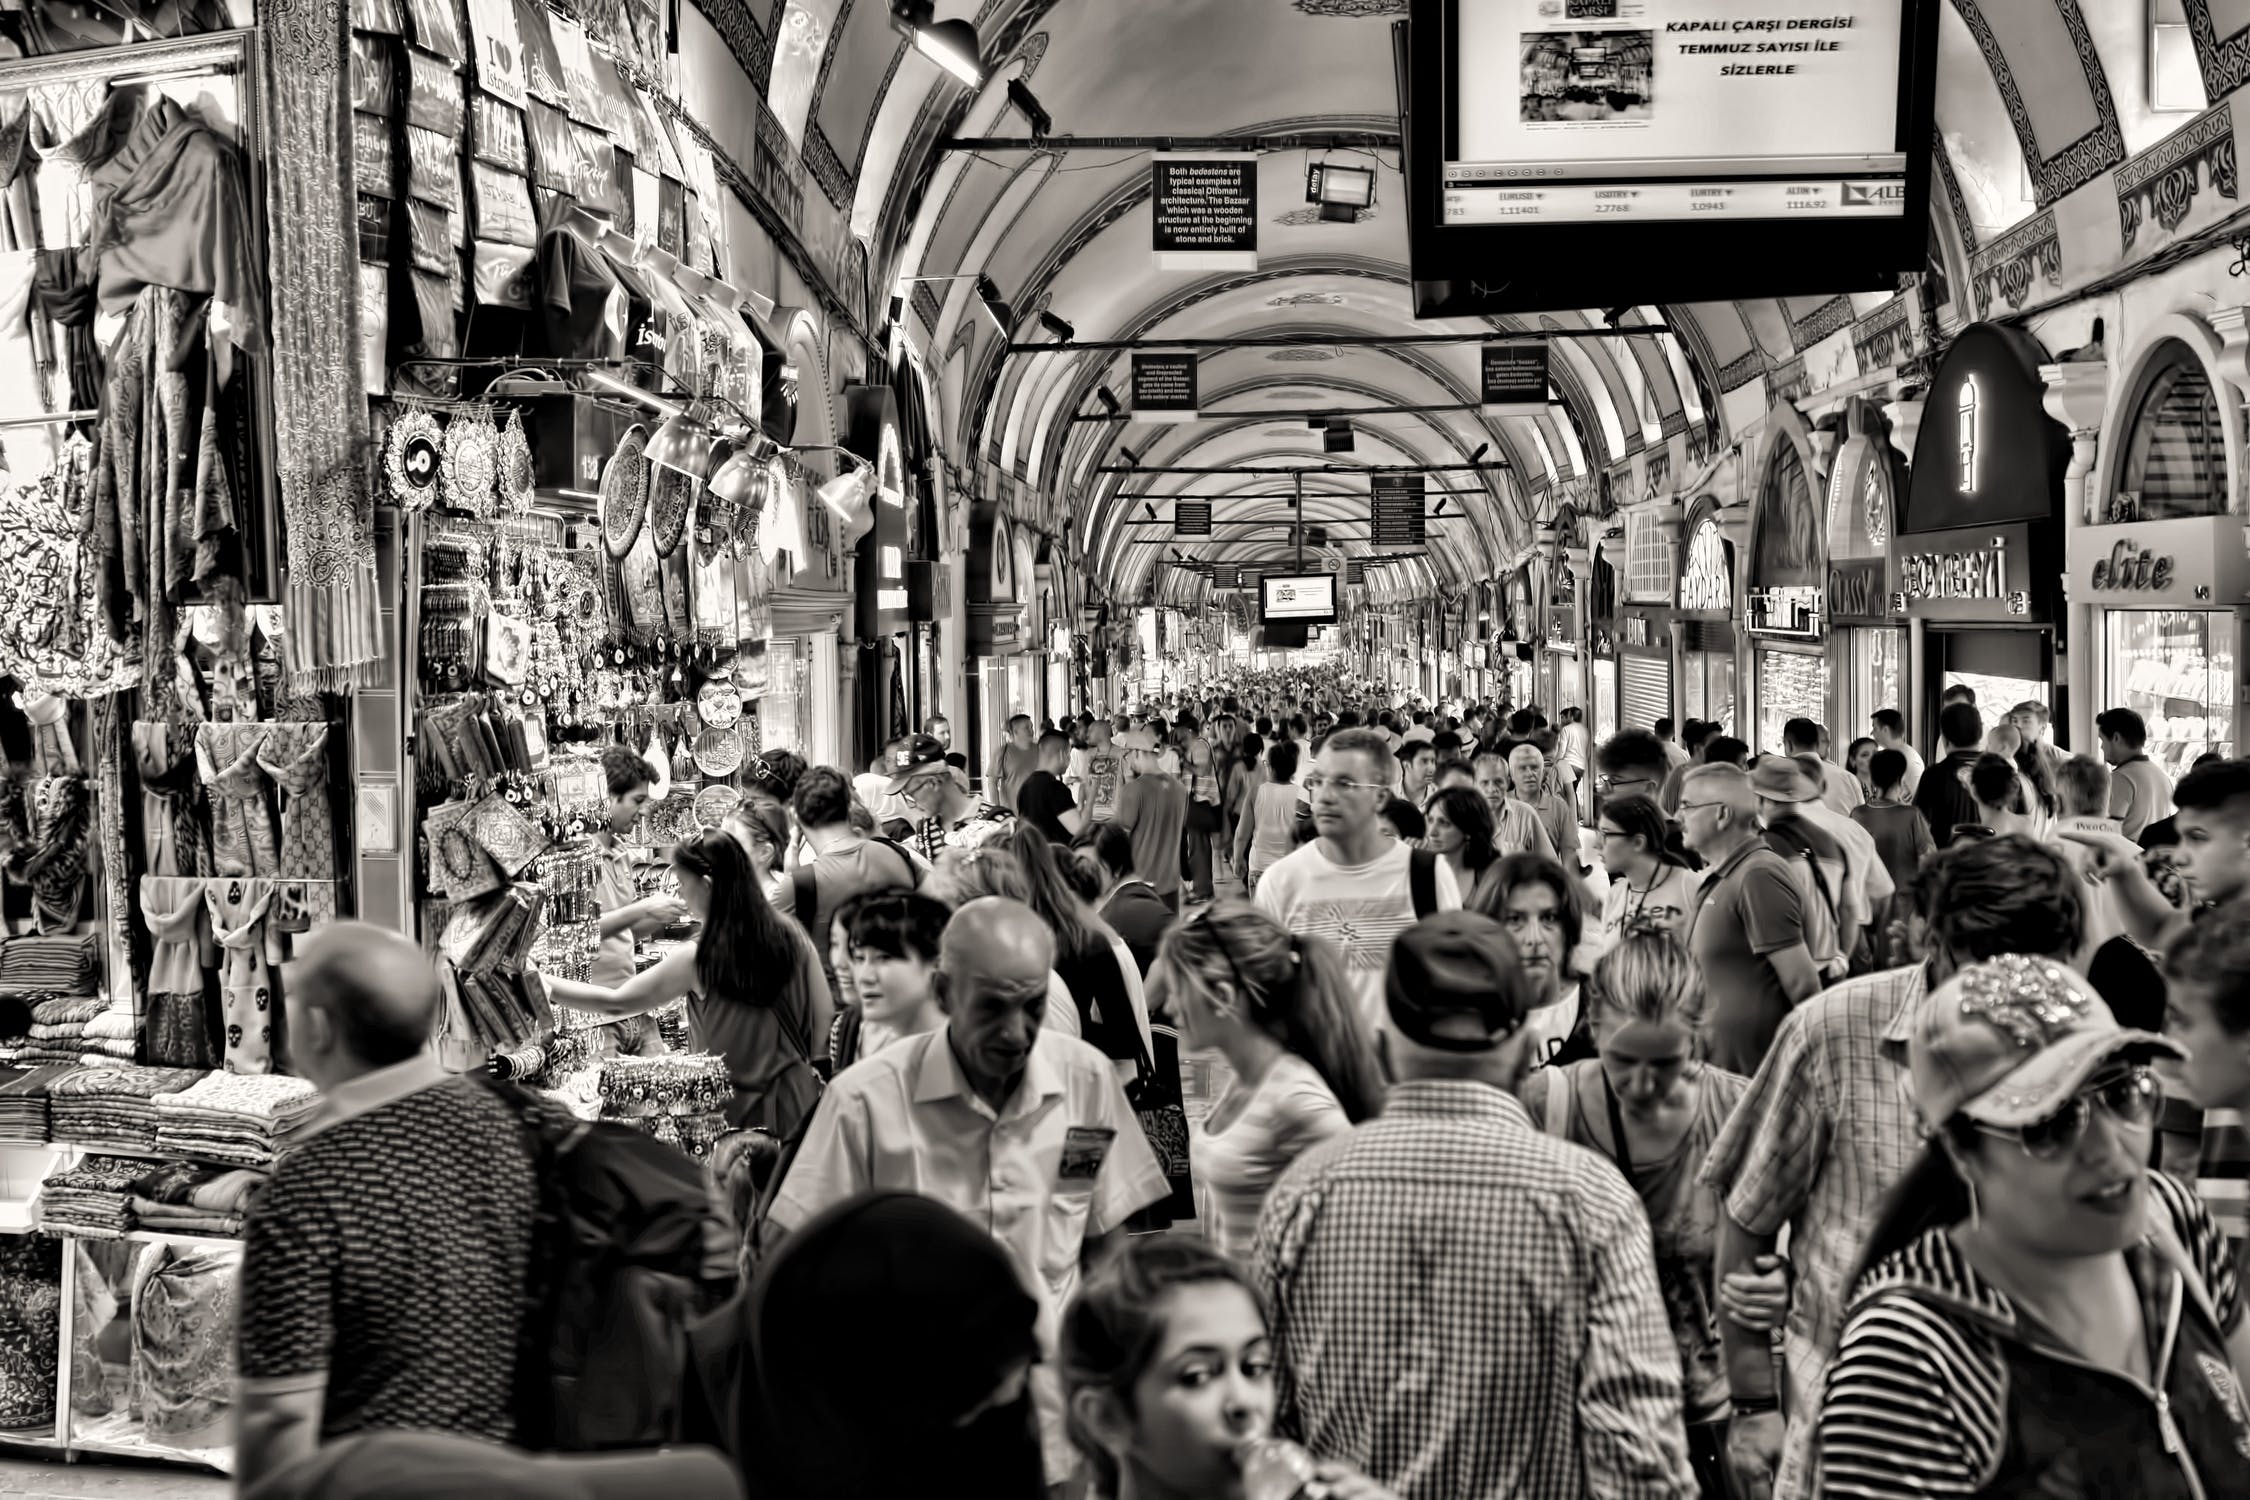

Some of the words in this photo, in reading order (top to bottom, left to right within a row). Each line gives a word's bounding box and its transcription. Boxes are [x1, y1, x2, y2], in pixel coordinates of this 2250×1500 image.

[1666, 21, 1726, 32] KAPALI
[1732, 20, 1781, 33] ÇARŞI
[1786, 16, 1855, 30] DERGİSİ
[1679, 43, 1751, 55] TEMMUZ
[1755, 42, 1810, 53] SAYISI
[1814, 40, 1841, 51] İLE
[1720, 63, 1796, 76] SİZLERLE
[1170, 177, 1195, 186] typical
[1196, 178, 1231, 186] examples
[1233, 177, 1241, 185] of
[1172, 187, 1205, 195] classical
[1206, 187, 1238, 195] Ottoman
[1595, 190, 1629, 199] USDTRY
[1167, 206, 1189, 214] which
[1214, 206, 1243, 214] wooden
[1158, 216, 1191, 224] structure
[1193, 216, 1200, 224] at
[1202, 216, 1214, 224] the
[1215, 216, 1252, 225] beginning
[1164, 226, 1172, 234] is
[1173, 226, 1189, 234] now
[1190, 226, 1218, 235] entirely
[1219, 226, 1236, 234] built
[1237, 226, 1246, 234] of
[1175, 235, 1196, 243] stone
[1198, 235, 1212, 243] and
[1213, 235, 1235, 243] brick.
[2092, 538, 2175, 591] elite
